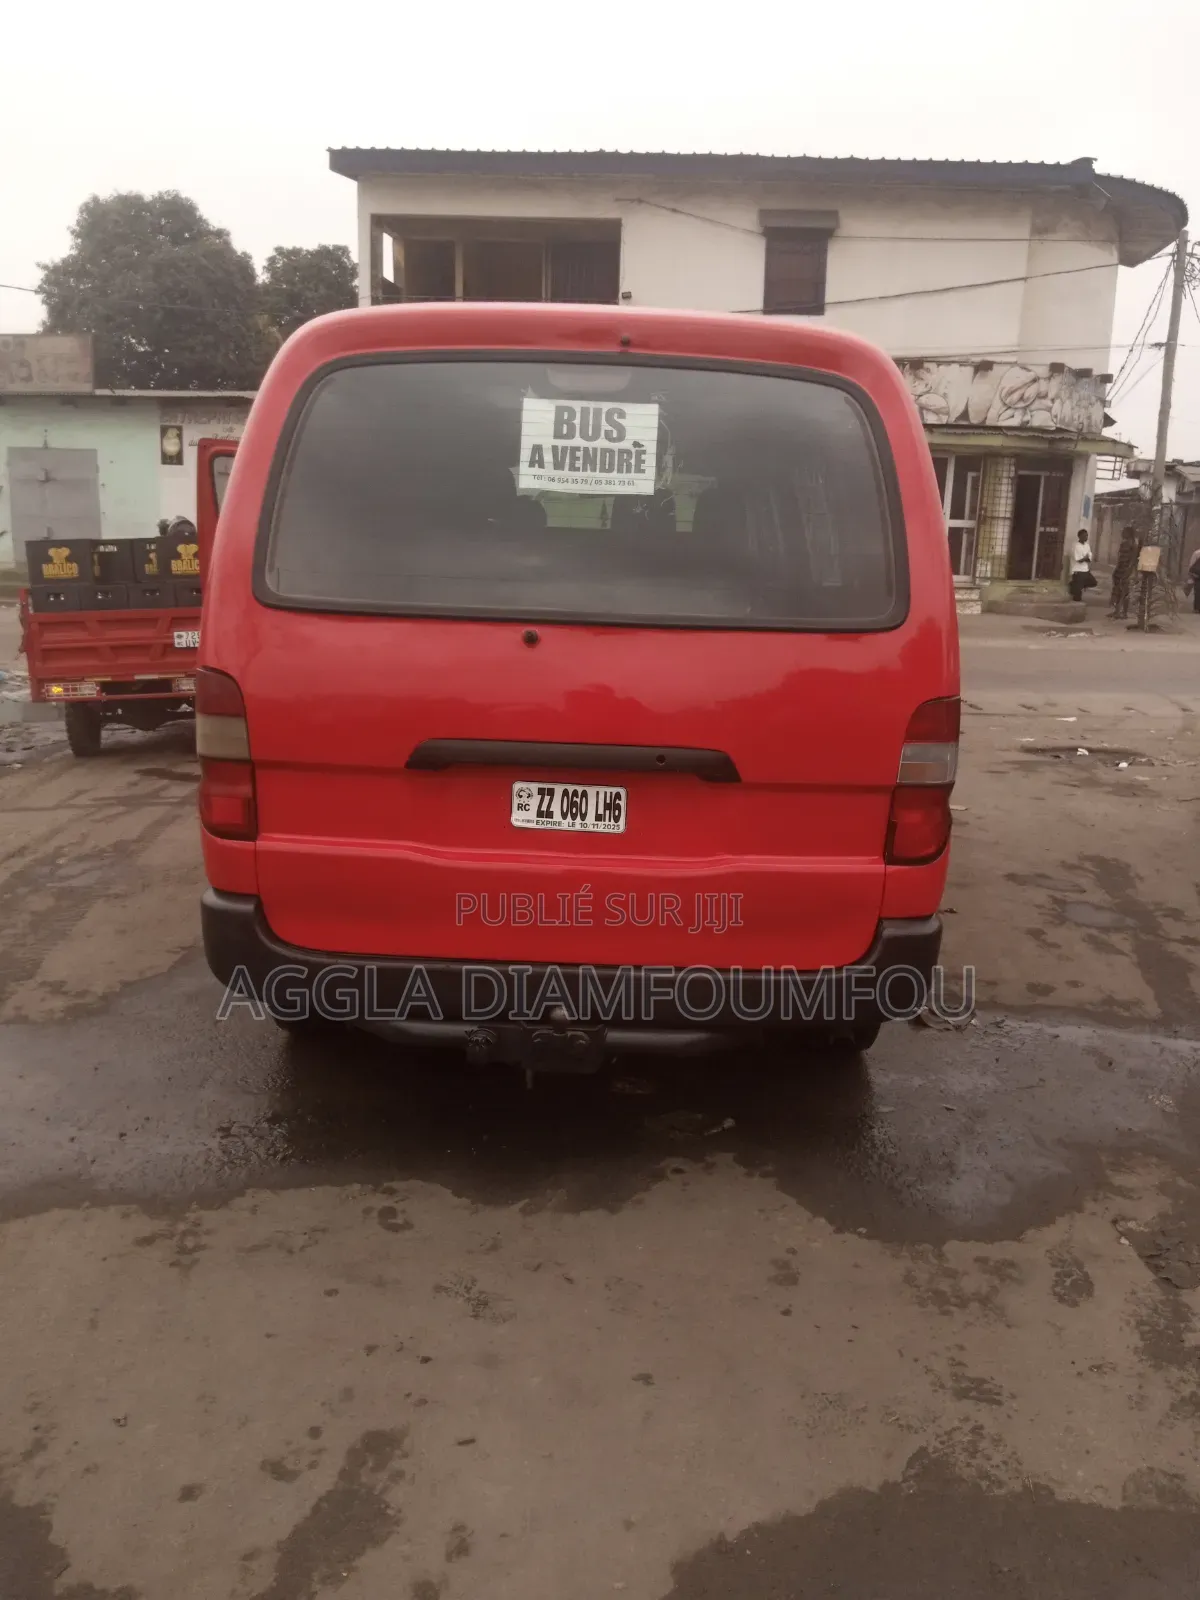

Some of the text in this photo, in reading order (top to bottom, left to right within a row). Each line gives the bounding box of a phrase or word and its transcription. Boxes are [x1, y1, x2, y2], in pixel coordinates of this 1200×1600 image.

[553, 405, 626, 443] BUS
[528, 443, 545, 469] A
[171, 559, 200, 571] BRALIC
[517, 803, 530, 811] RC
[536, 787, 555, 818] ZZ
[560, 788, 588, 821] 060
[594, 791, 621, 823] LH6
